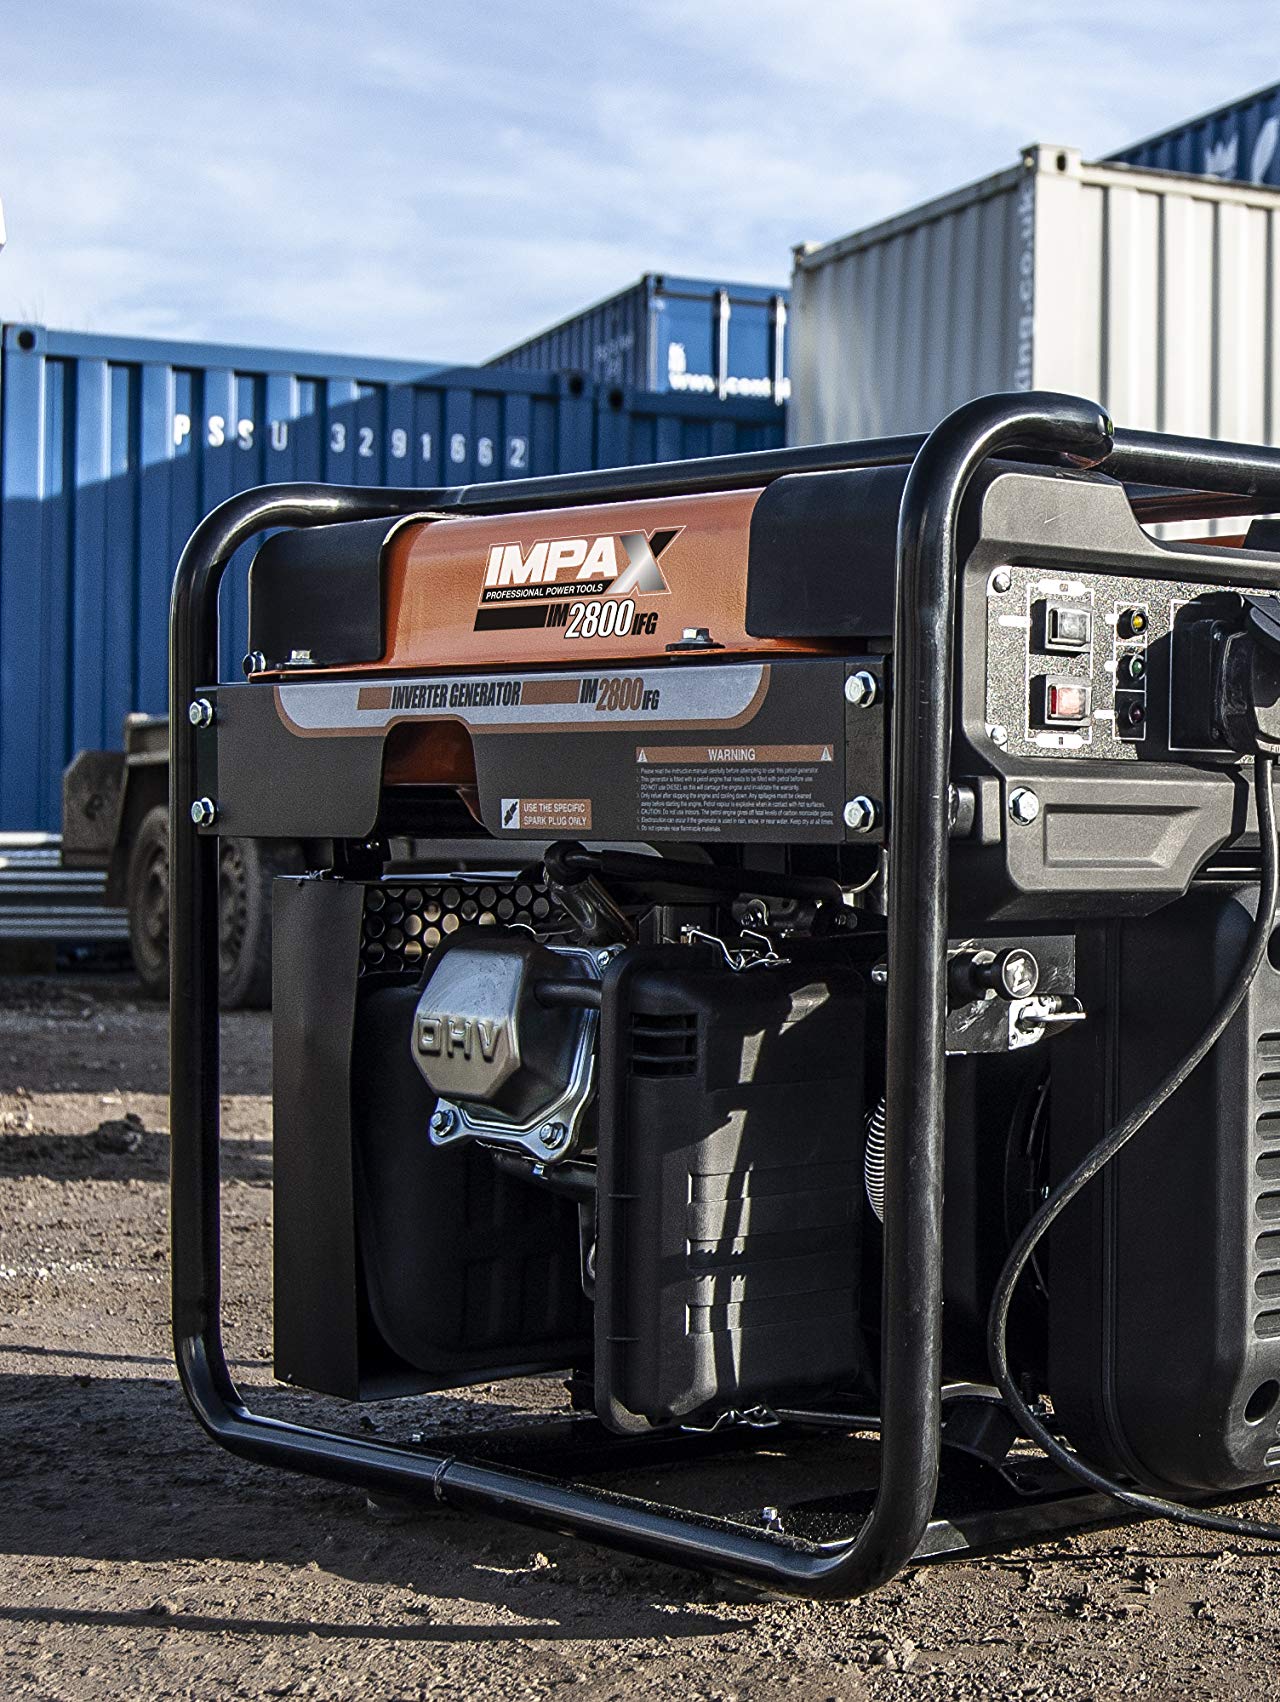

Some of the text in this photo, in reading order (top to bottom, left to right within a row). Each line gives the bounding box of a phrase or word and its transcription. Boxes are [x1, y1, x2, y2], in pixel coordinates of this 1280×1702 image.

[174, 413, 526, 468] PSSU 3291662
[484, 529, 679, 594] IMPAX
[486, 584, 603, 600] PROFESSIONAL POWER TOOLS
[391, 684, 449, 710] INVERTER
[449, 681, 521, 708] GENERATOR
[707, 749, 756, 761] WARNING
[524, 803, 585, 813] USE THE SPECIFIC
[524, 816, 587, 826] SPARK PLUG ONLY
[417, 1017, 501, 1064] OHV
